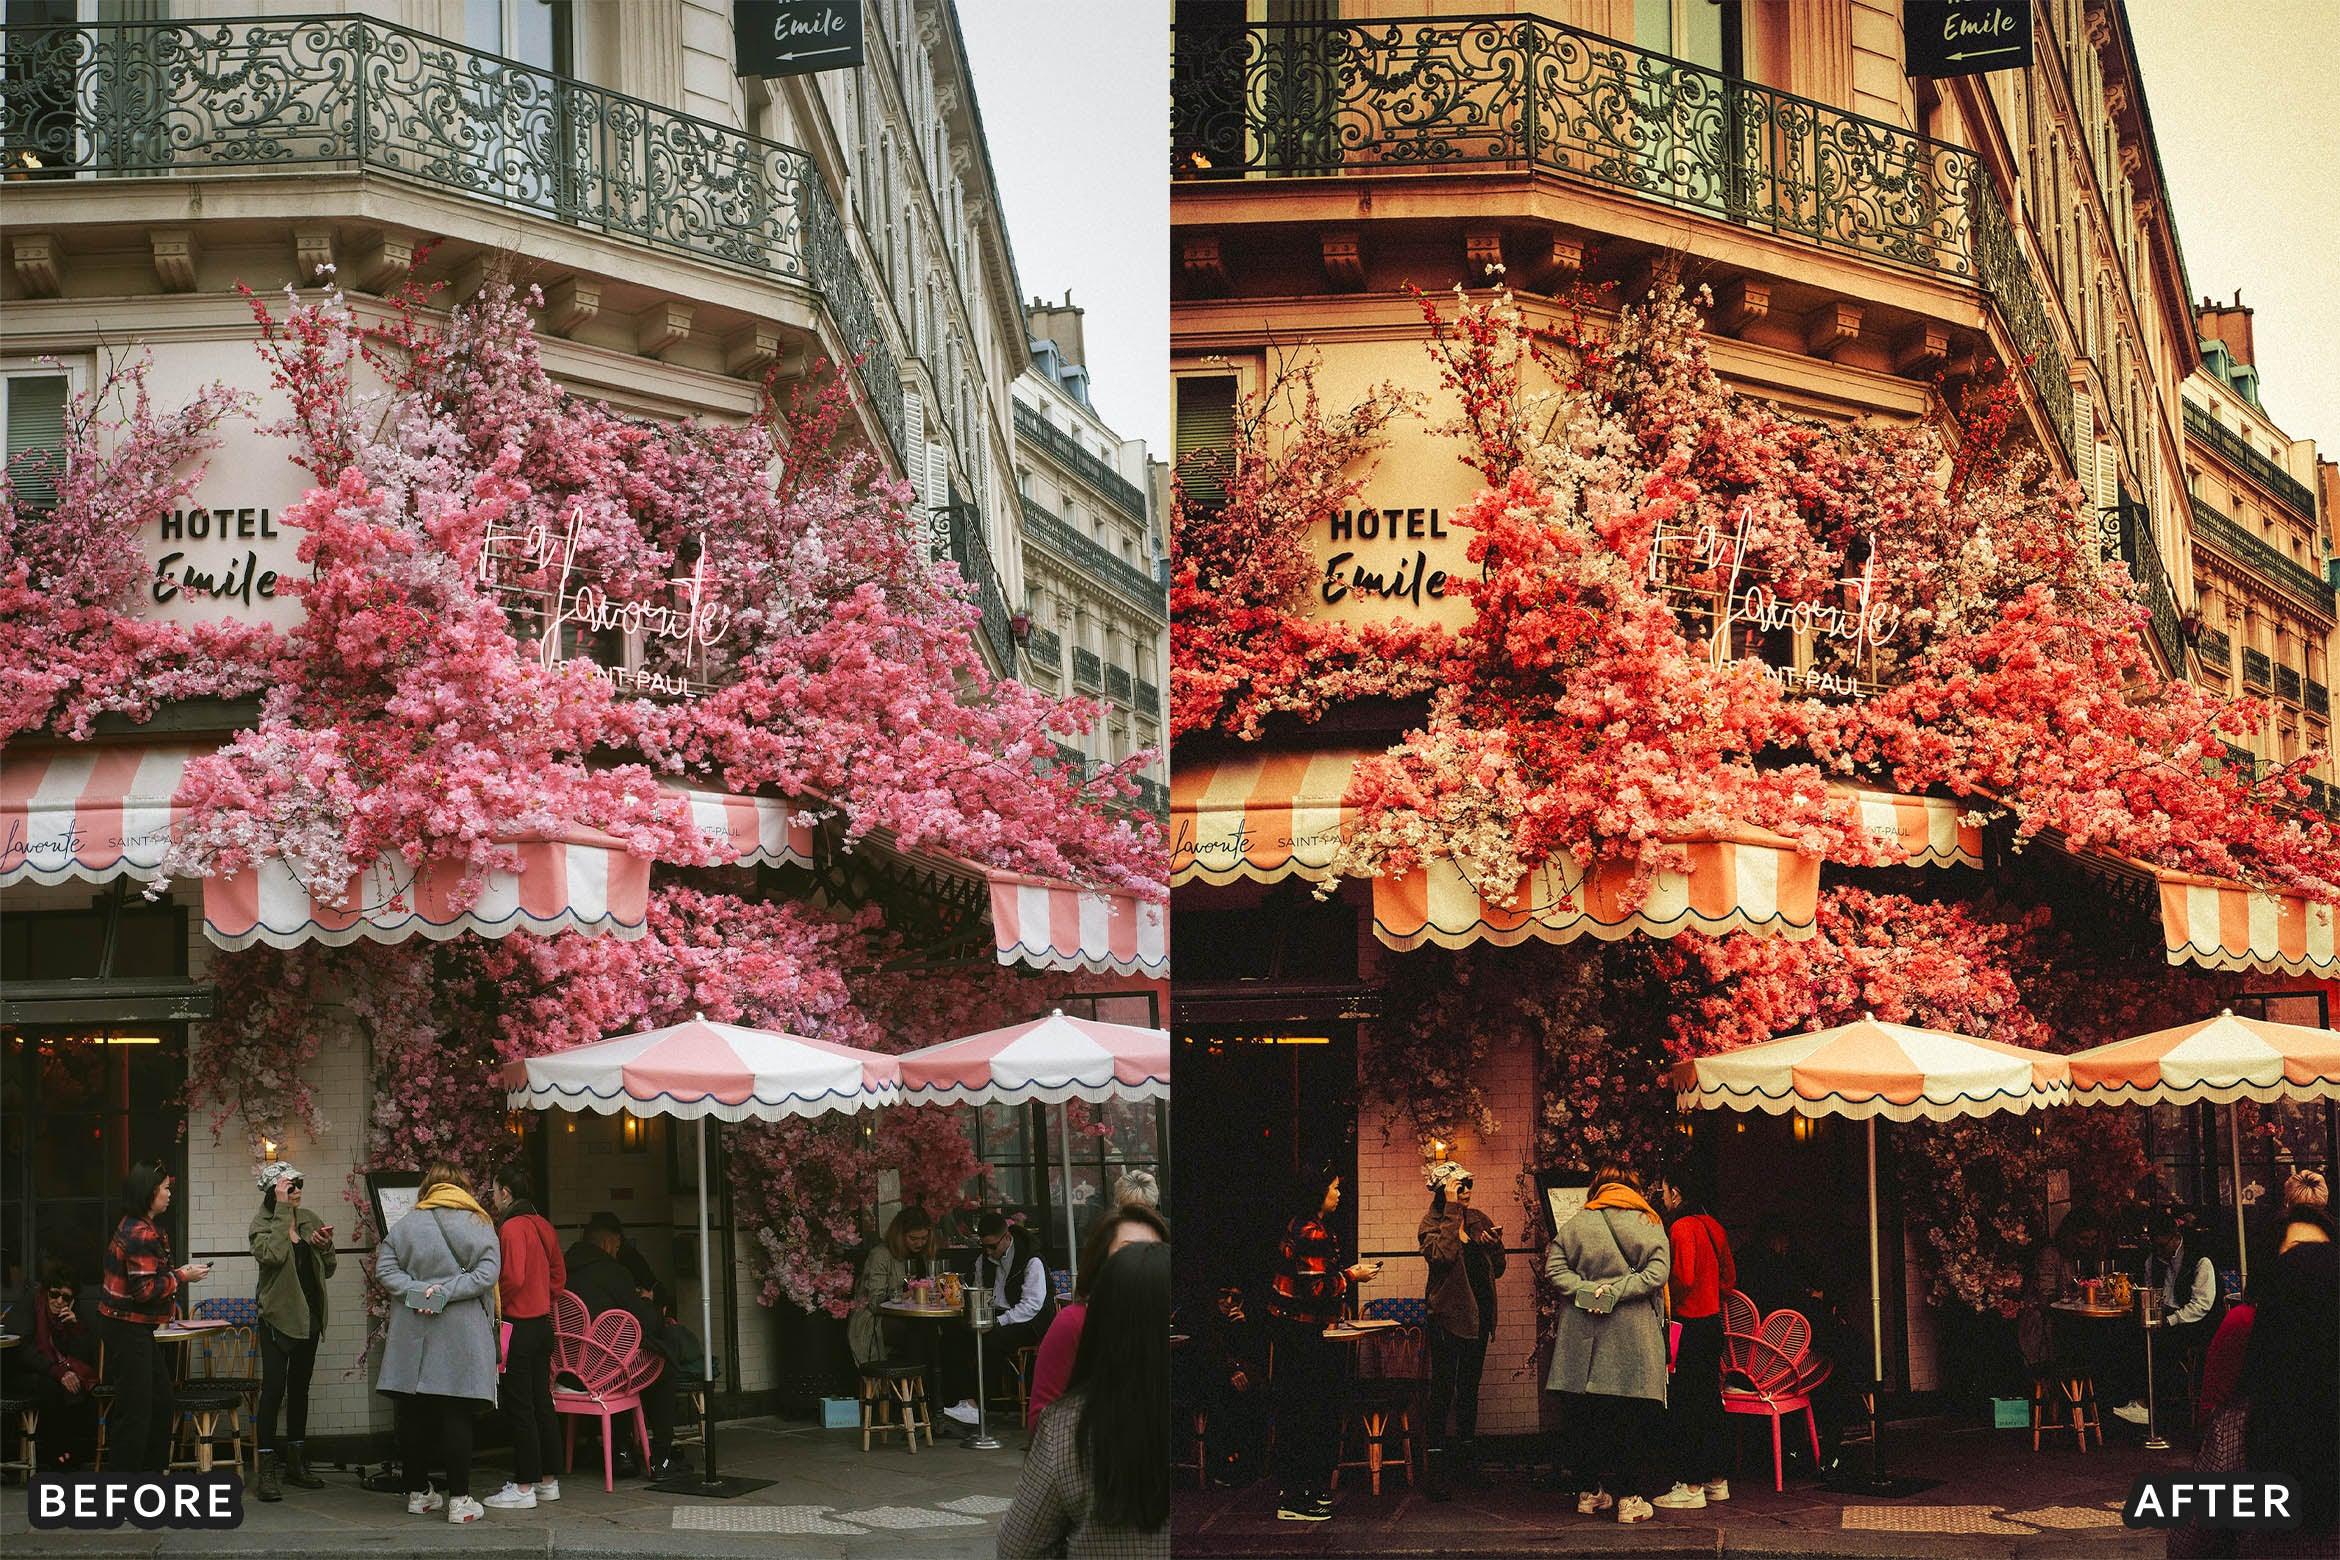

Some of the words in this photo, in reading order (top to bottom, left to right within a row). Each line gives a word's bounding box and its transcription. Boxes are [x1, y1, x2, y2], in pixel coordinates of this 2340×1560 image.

[774, 7, 847, 40] Emile
[1944, 7, 2017, 40] Emile
[161, 508, 278, 539] HOTEL
[1330, 508, 1448, 539] HOTEL
[153, 550, 278, 607] Emile
[1322, 550, 1447, 607] Emile
[559, 660, 697, 698] NT-PAUL
[1728, 660, 1867, 698] NT-PAUL
[0, 819, 87, 868] favorite
[701, 825, 741, 837] NT-PAUL
[1170, 819, 1257, 868] favorite
[1871, 825, 1911, 837] NT-PAUL
